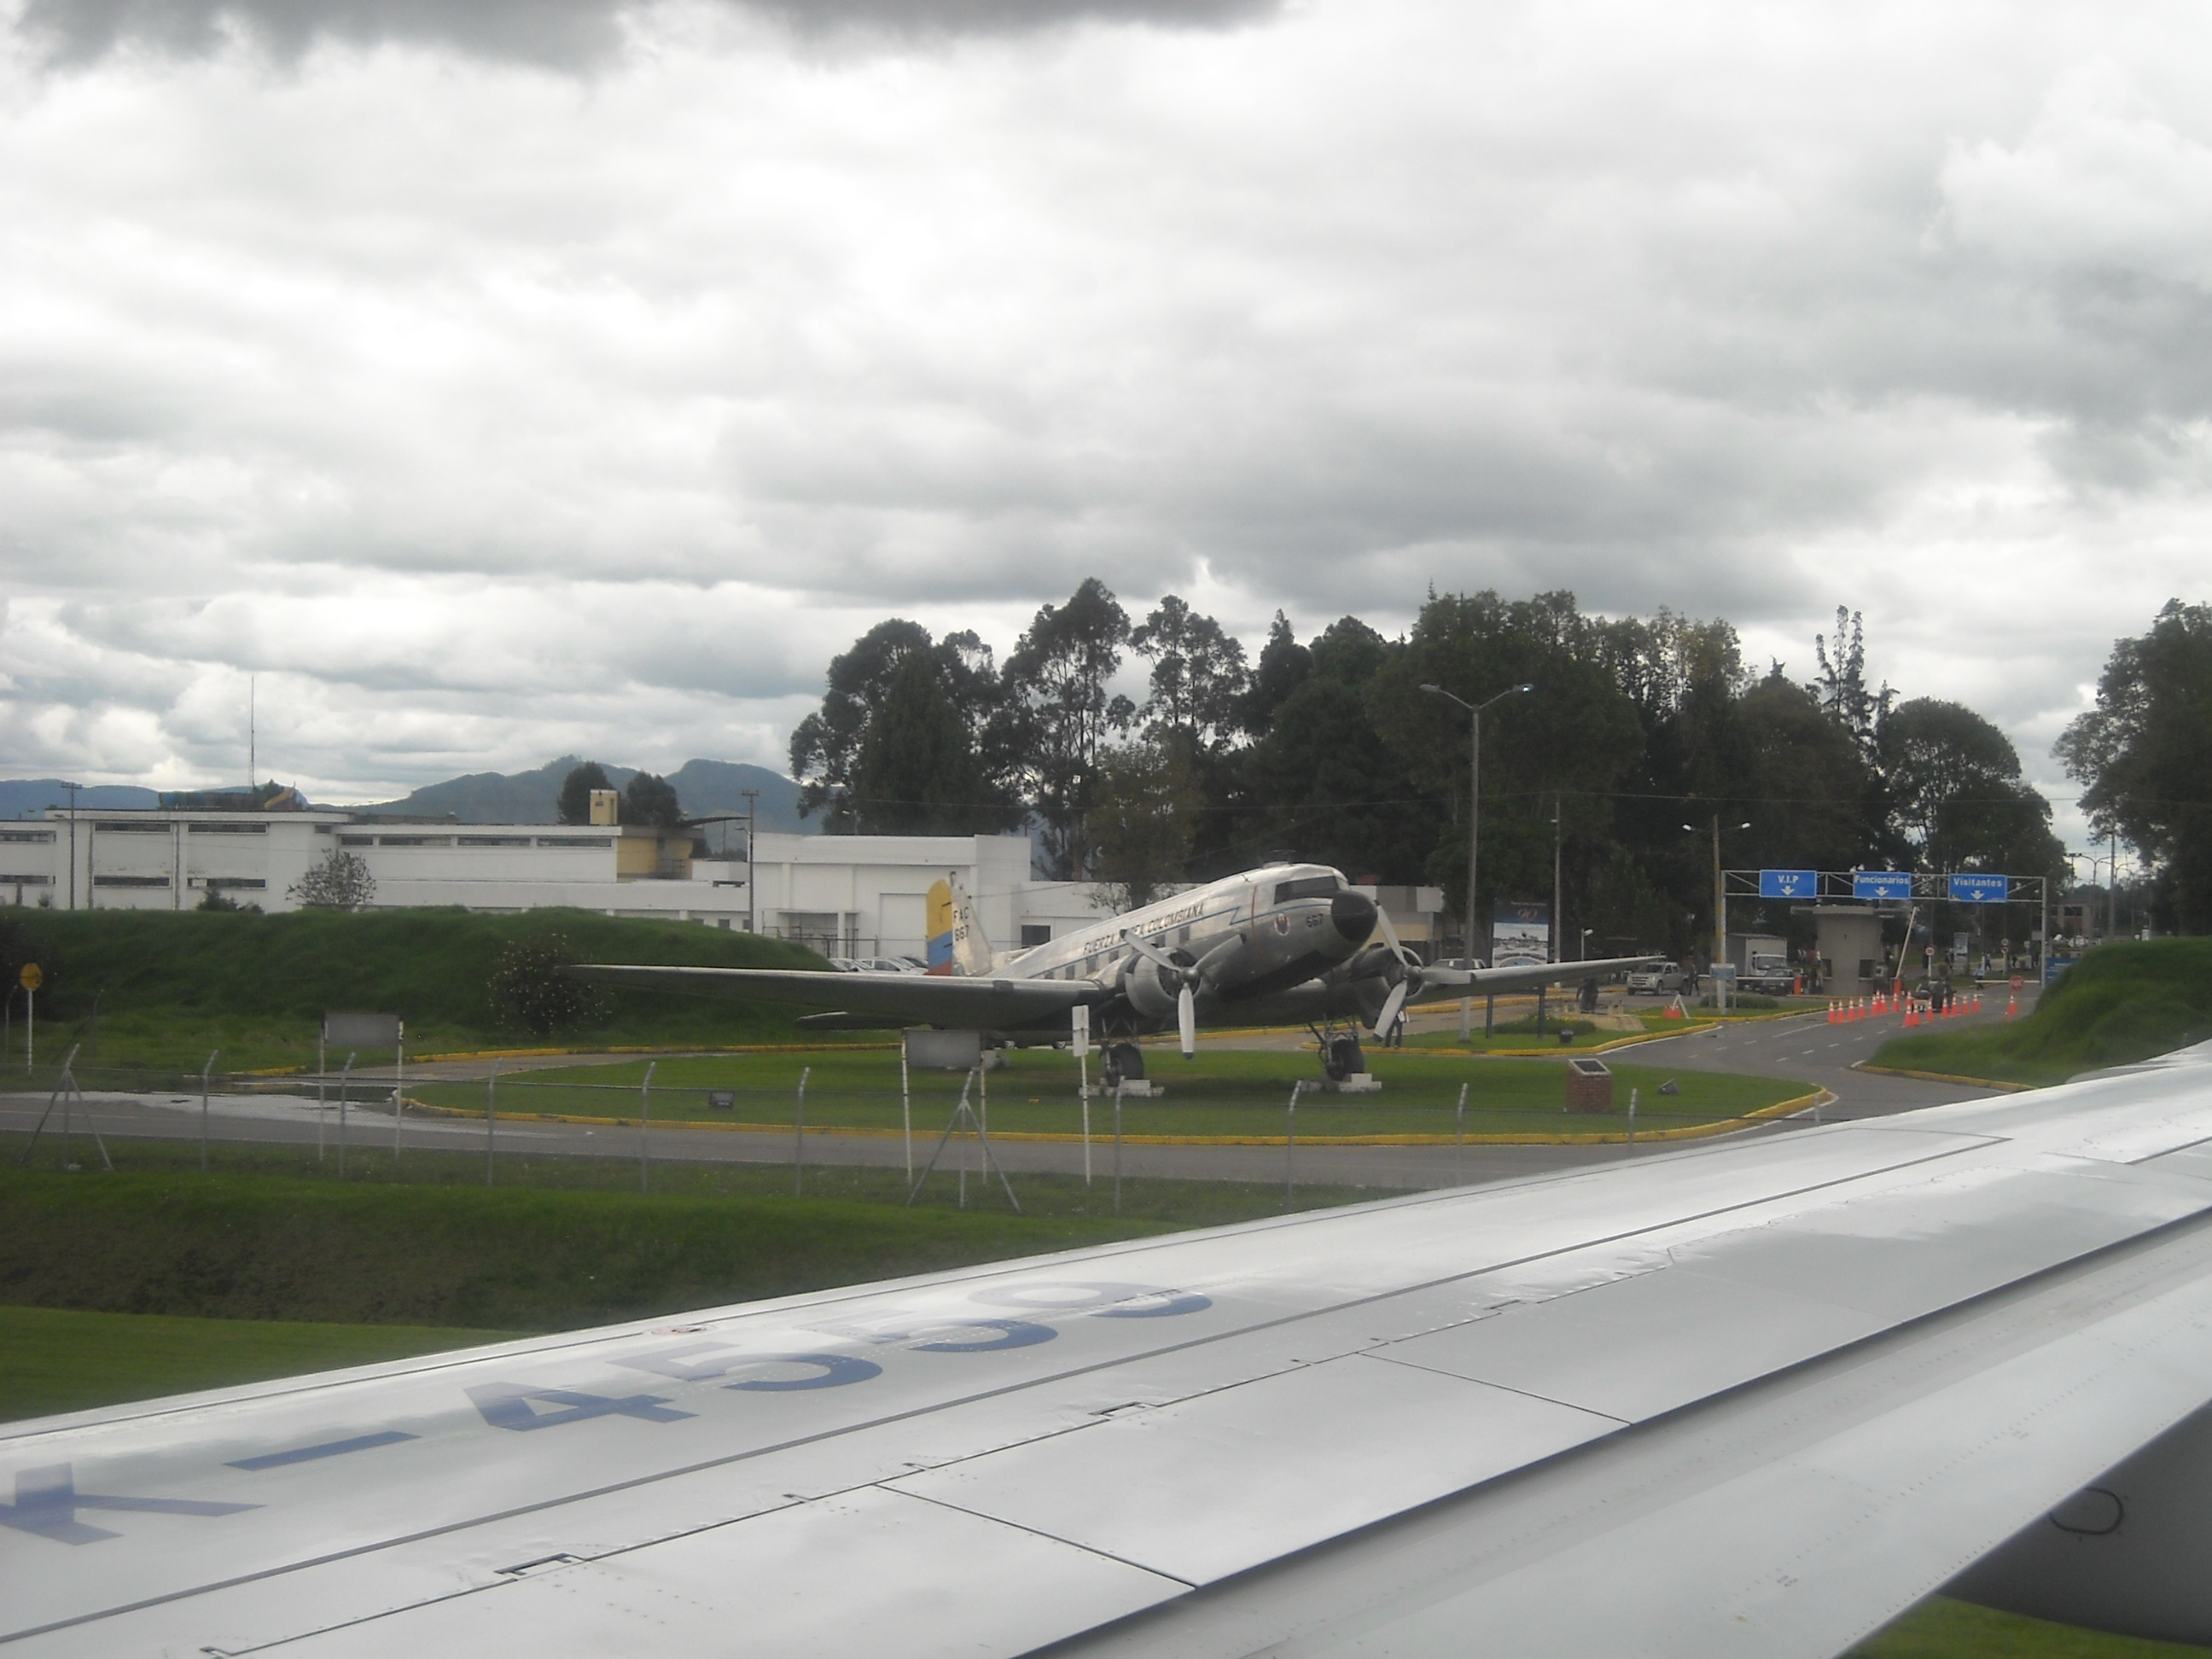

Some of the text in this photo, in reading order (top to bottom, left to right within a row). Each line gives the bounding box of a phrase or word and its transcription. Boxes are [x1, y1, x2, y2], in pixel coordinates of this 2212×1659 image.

[1854, 875, 1909, 885] Funcionarios
[1953, 877, 2002, 887] Visitantes
[953, 906, 969, 923] FAC
[1306, 913, 1324, 928] 667
[955, 924, 969, 941] 667
[1083, 934, 1114, 955] FUERZA
[1147, 902, 1203, 933] COLOMBIANA
